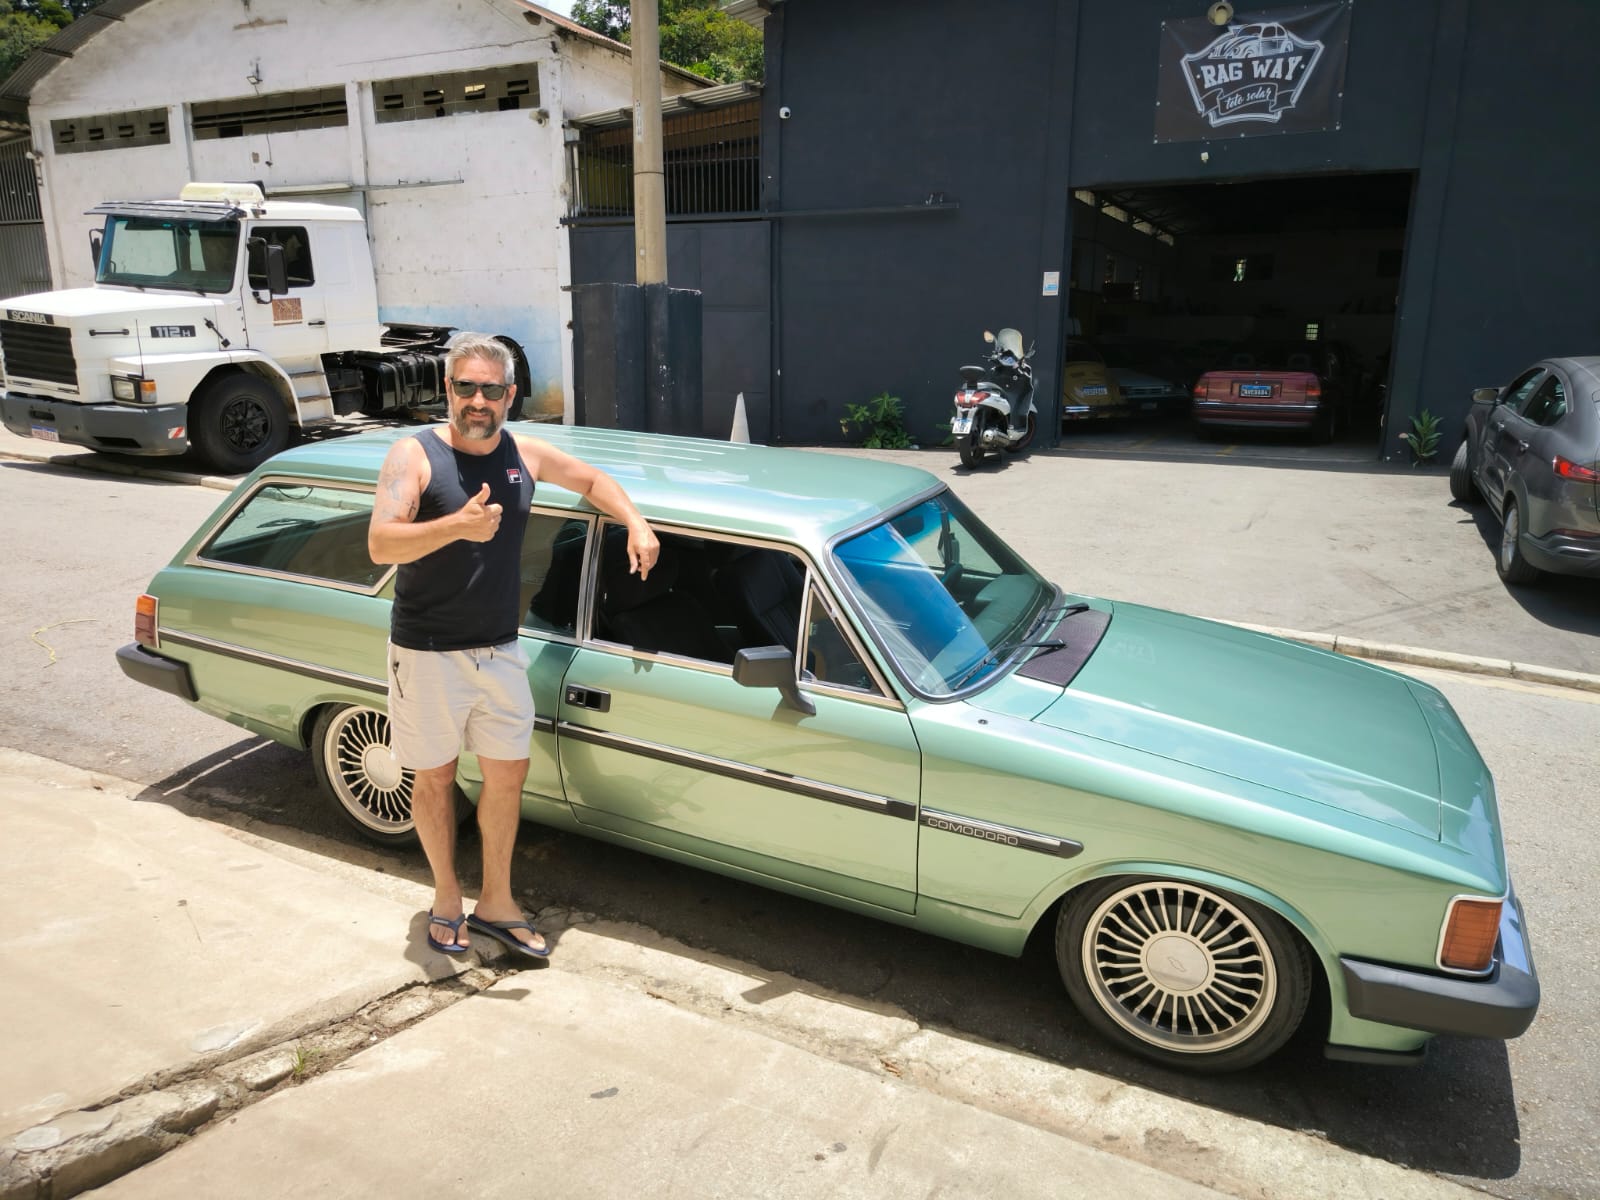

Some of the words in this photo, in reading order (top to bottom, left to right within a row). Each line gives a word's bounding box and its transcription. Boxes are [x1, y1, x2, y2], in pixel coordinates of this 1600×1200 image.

[1201, 62, 1243, 88] RAG
[1252, 56, 1303, 80] WAY
[11, 310, 48, 324] SCANIA
[927, 817, 1019, 846] COMODORO
